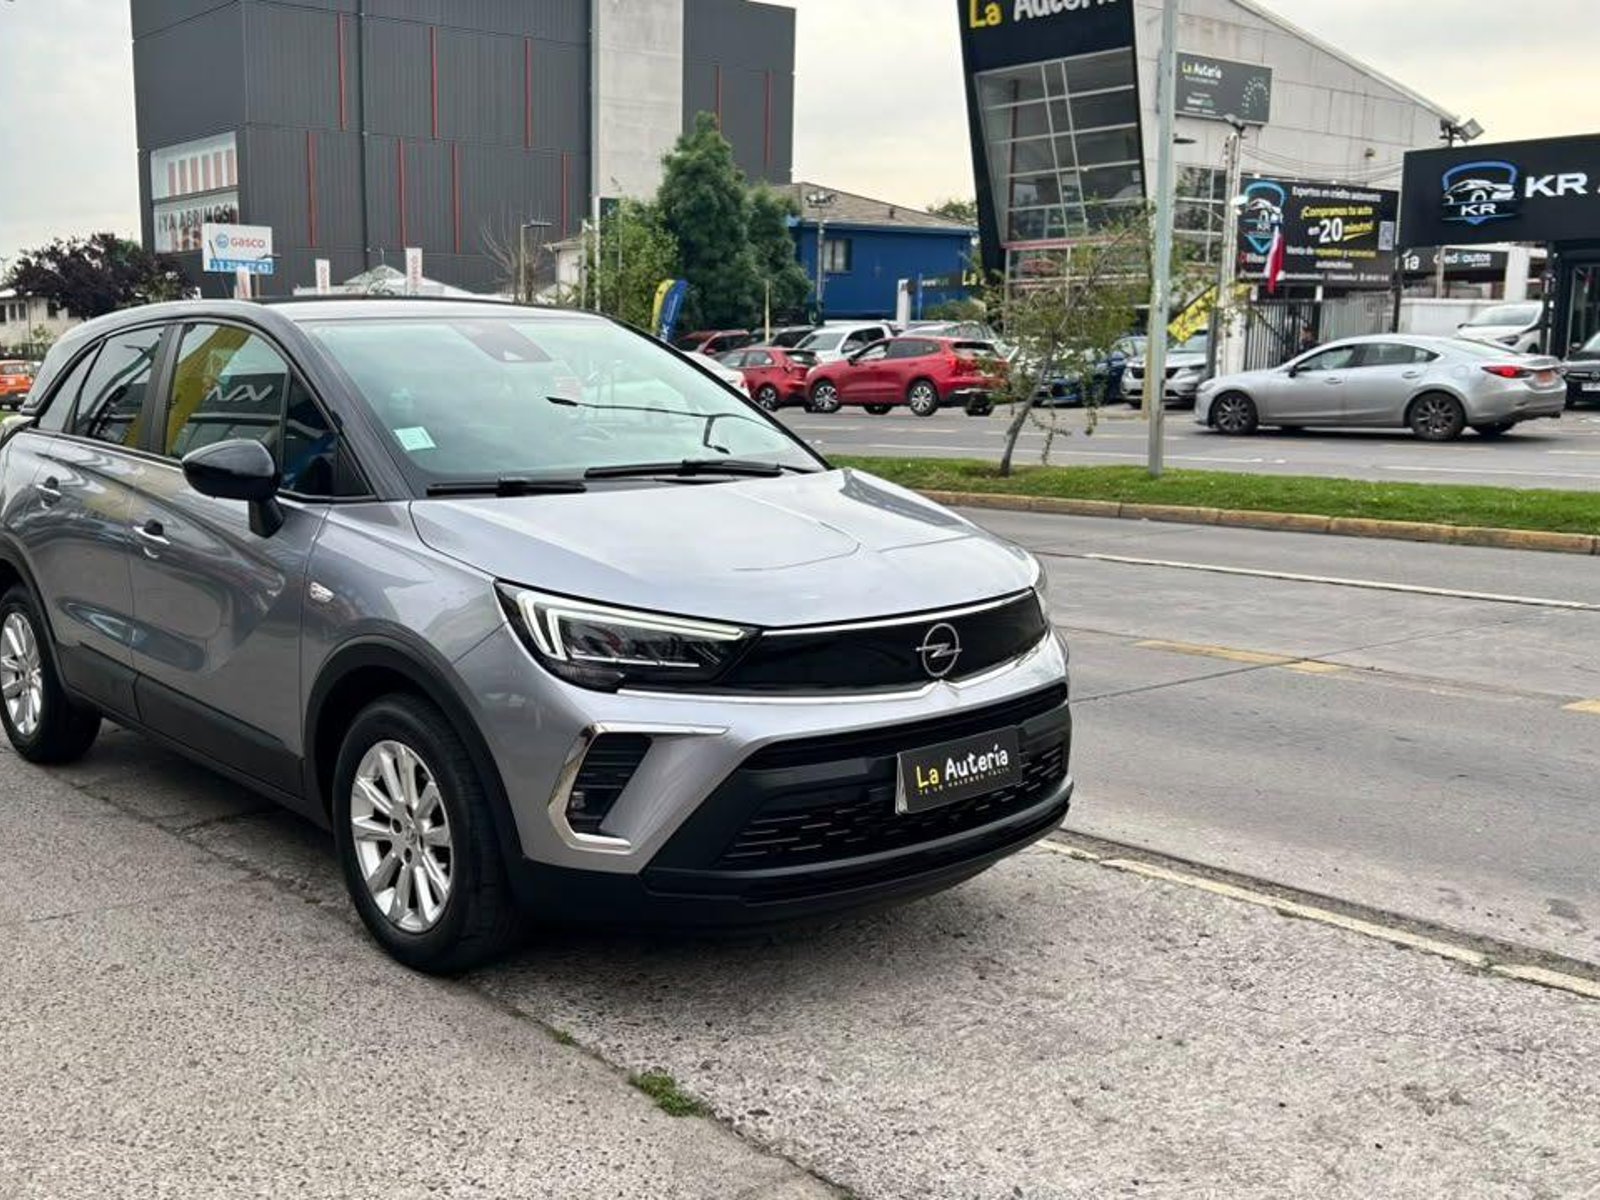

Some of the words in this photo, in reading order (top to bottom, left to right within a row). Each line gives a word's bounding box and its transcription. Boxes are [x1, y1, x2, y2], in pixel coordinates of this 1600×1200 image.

[1524, 172, 1588, 198] KR
[1460, 203, 1497, 216] KR
[1319, 217, 1344, 244] 20
[916, 765, 940, 788] La
[945, 743, 1009, 781] Autería
